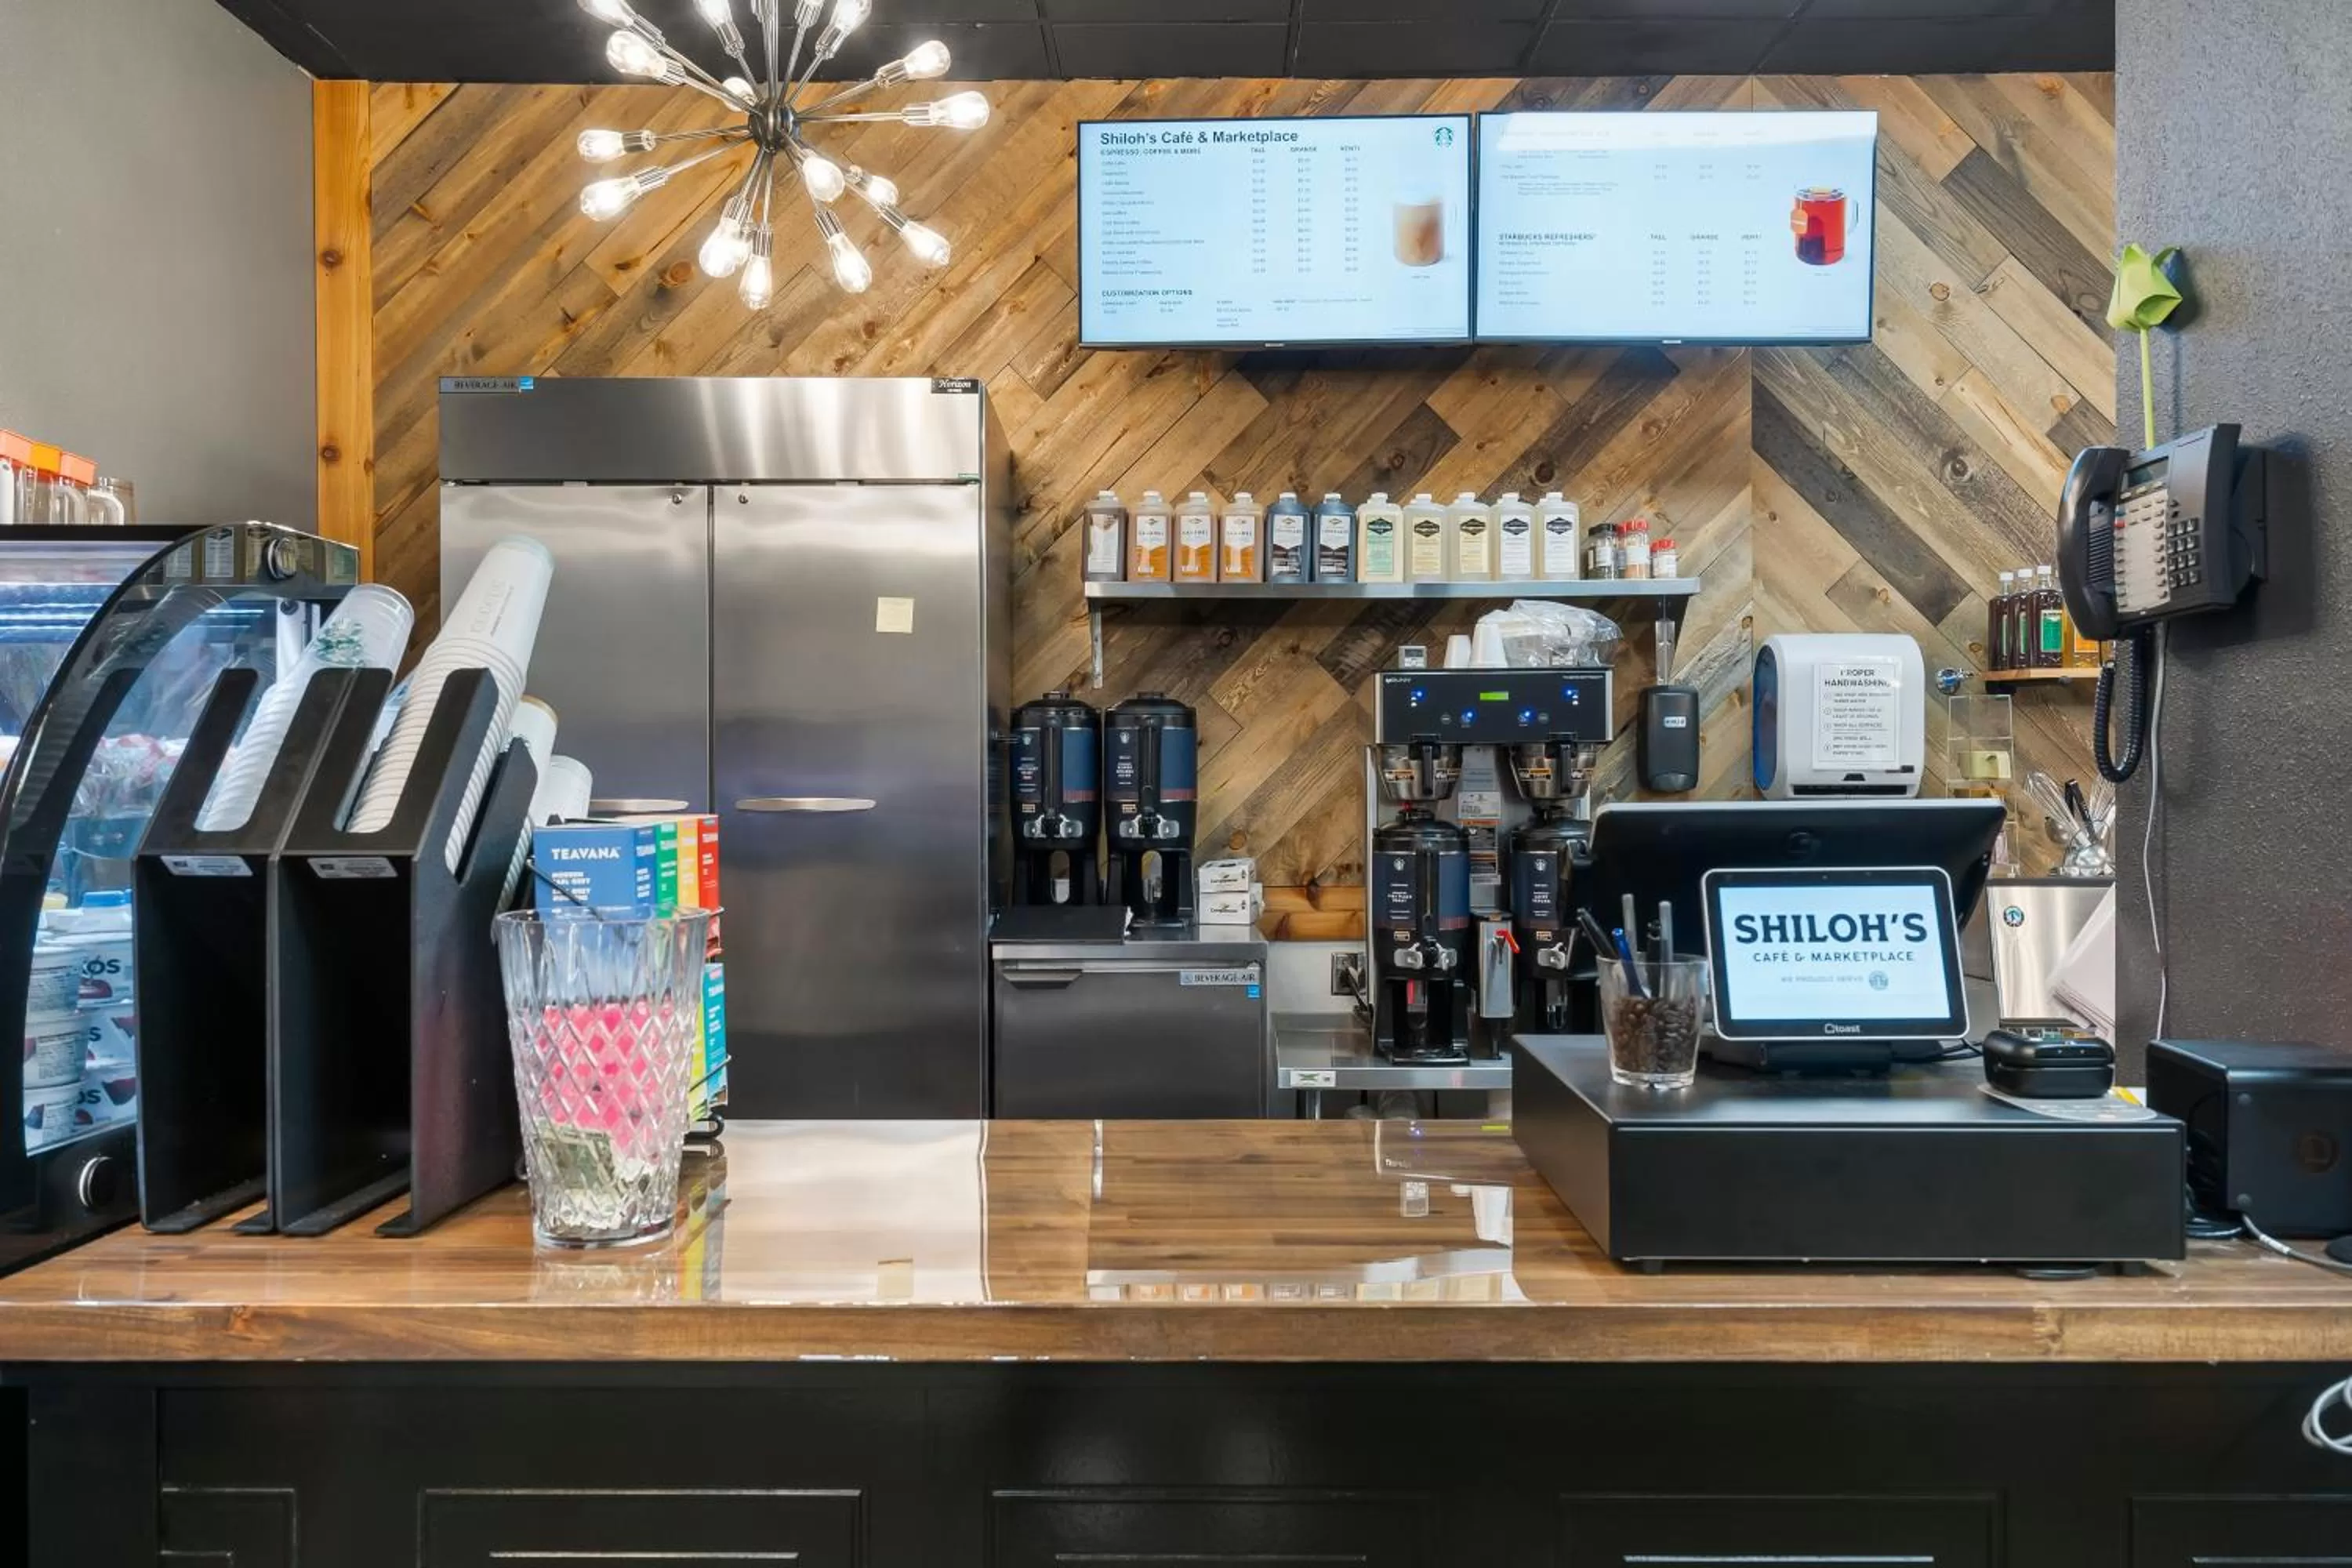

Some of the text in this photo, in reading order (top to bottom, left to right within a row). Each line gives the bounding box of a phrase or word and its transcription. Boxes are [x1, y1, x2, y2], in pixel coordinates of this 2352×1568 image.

[1100, 130, 1298, 145] Shiloh's Café & Marketplace
[551, 847, 620, 860] TEAVANA
[1734, 913, 1928, 944] SHILOH'S
[1795, 952, 1805, 962] &
[1811, 951, 1915, 962] MARKETPLACE
[1835, 1023, 1860, 1033] toast
